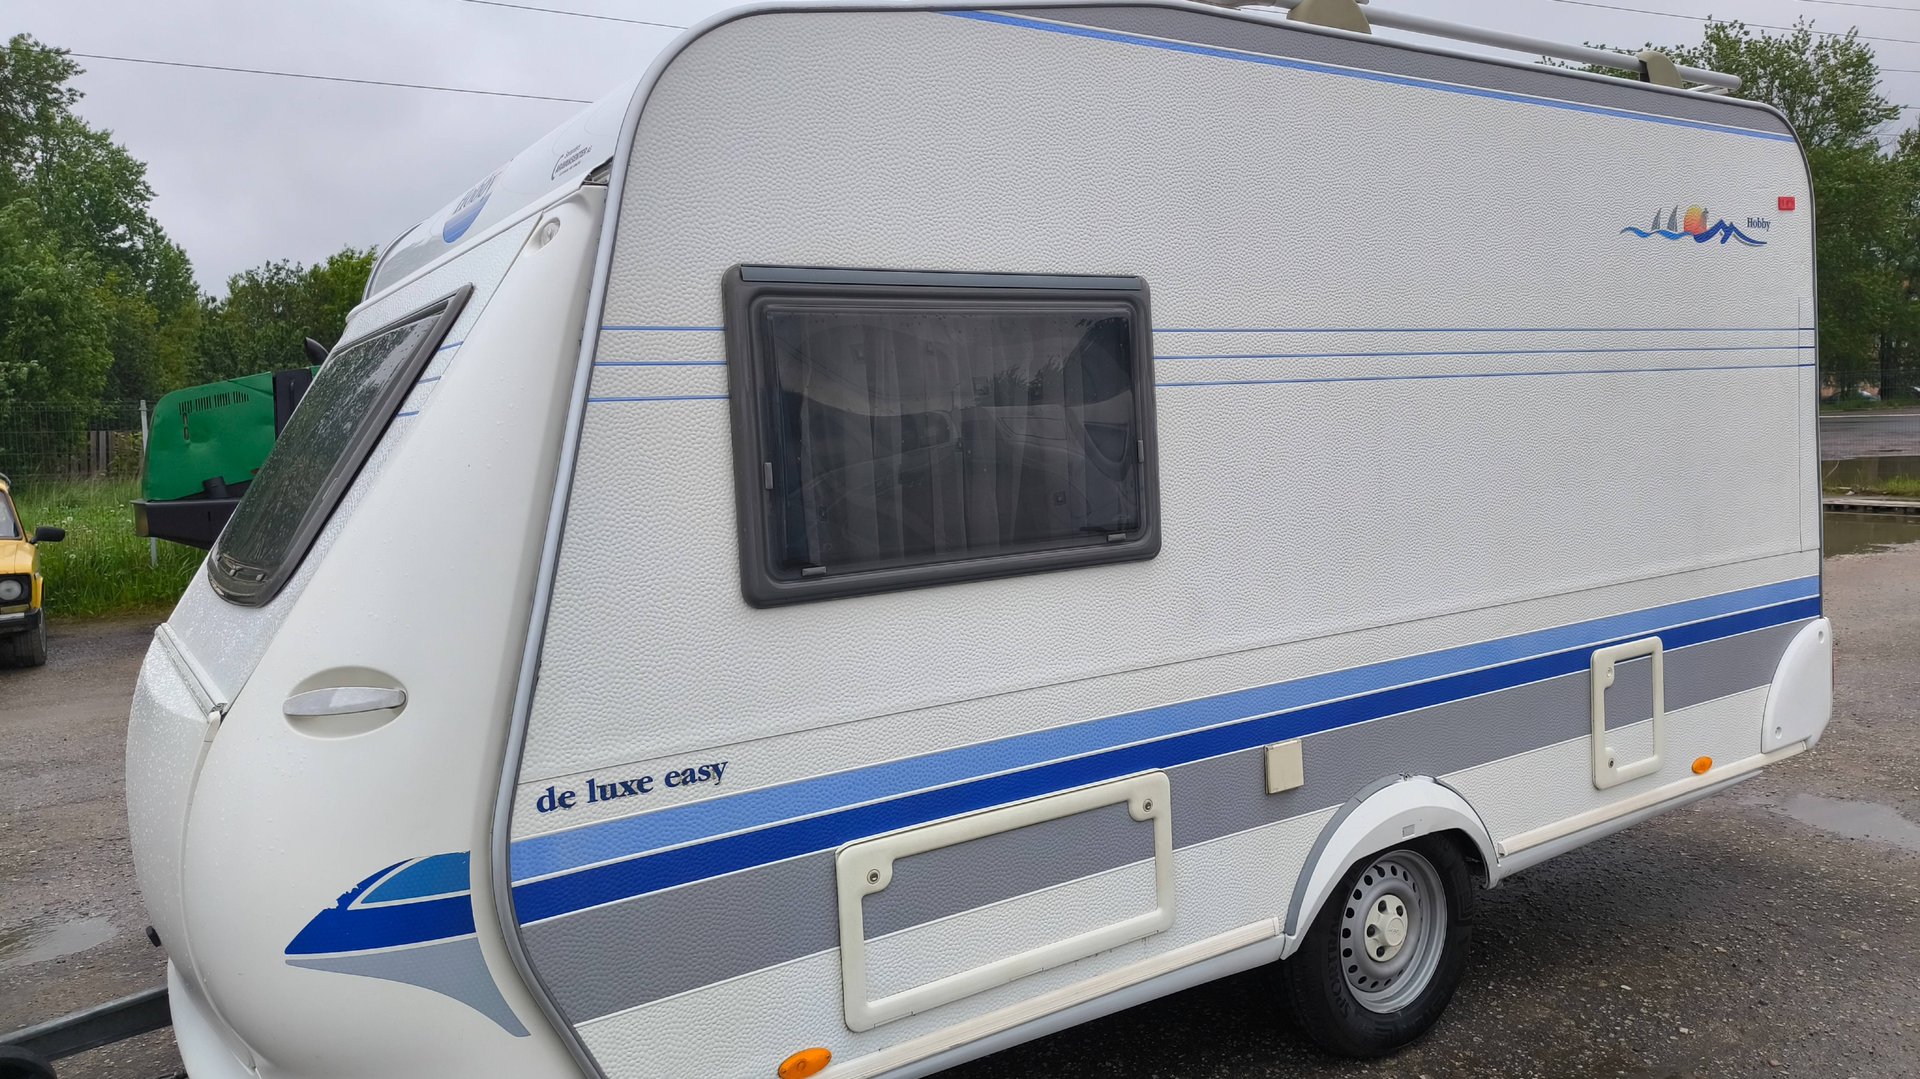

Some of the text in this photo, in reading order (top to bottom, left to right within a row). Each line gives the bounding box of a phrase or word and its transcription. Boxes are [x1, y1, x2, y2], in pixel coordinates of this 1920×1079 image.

[1747, 217, 1771, 232] Hobby
[536, 761, 729, 813] de luxe easy
